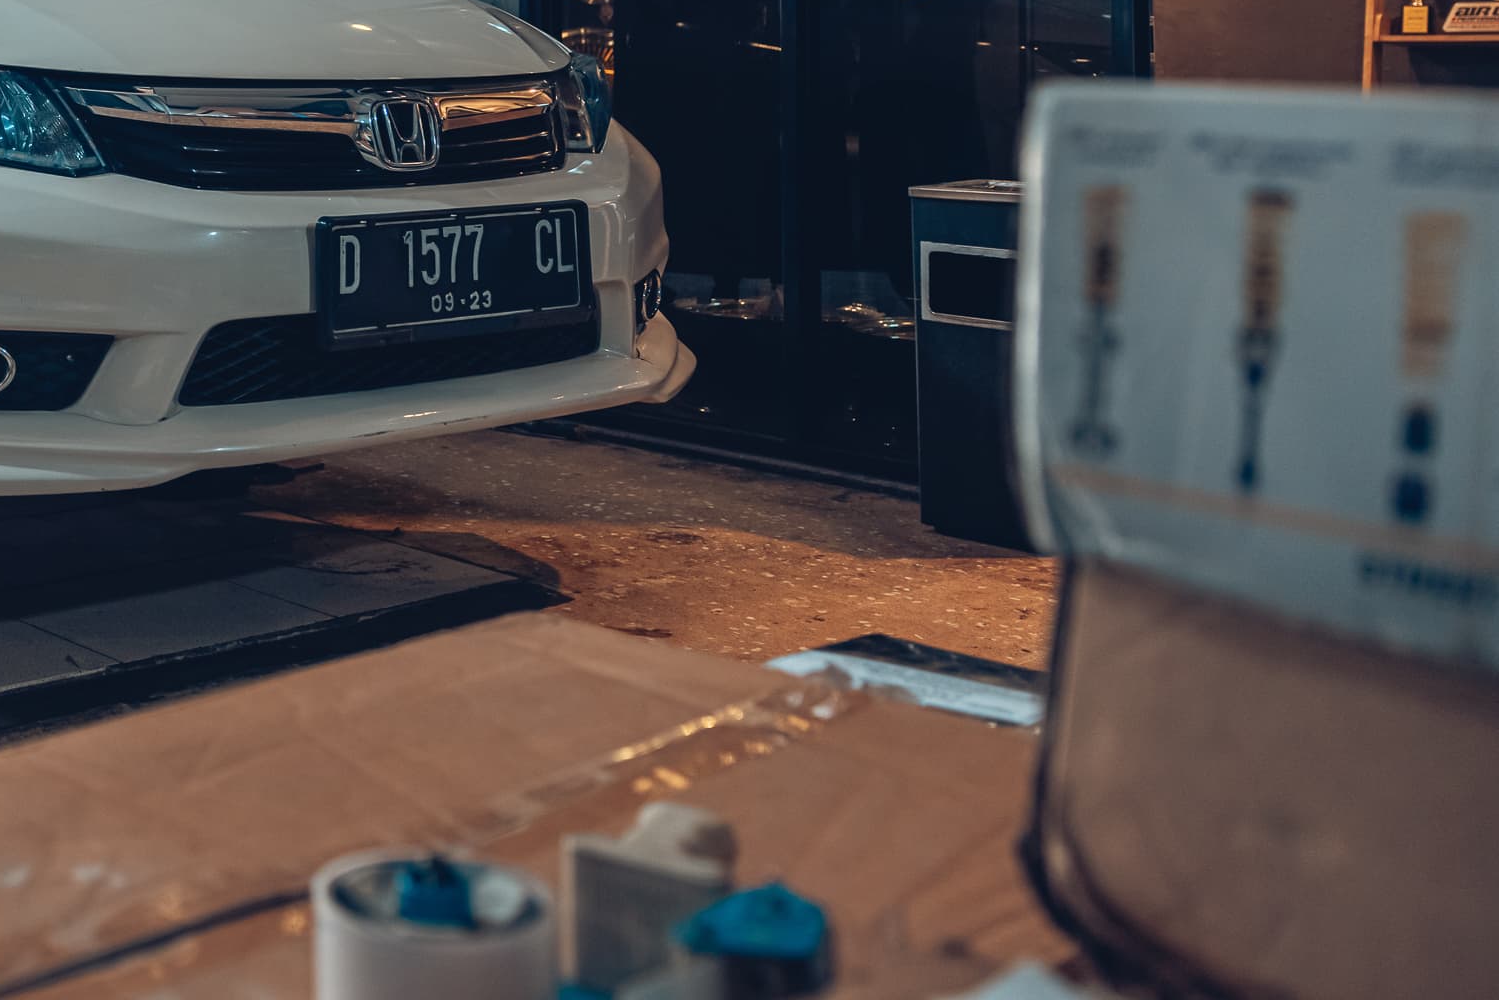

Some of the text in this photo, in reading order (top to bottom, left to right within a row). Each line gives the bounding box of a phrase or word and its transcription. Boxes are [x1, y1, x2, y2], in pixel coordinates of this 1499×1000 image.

[339, 218, 574, 294] D 1577 CL
